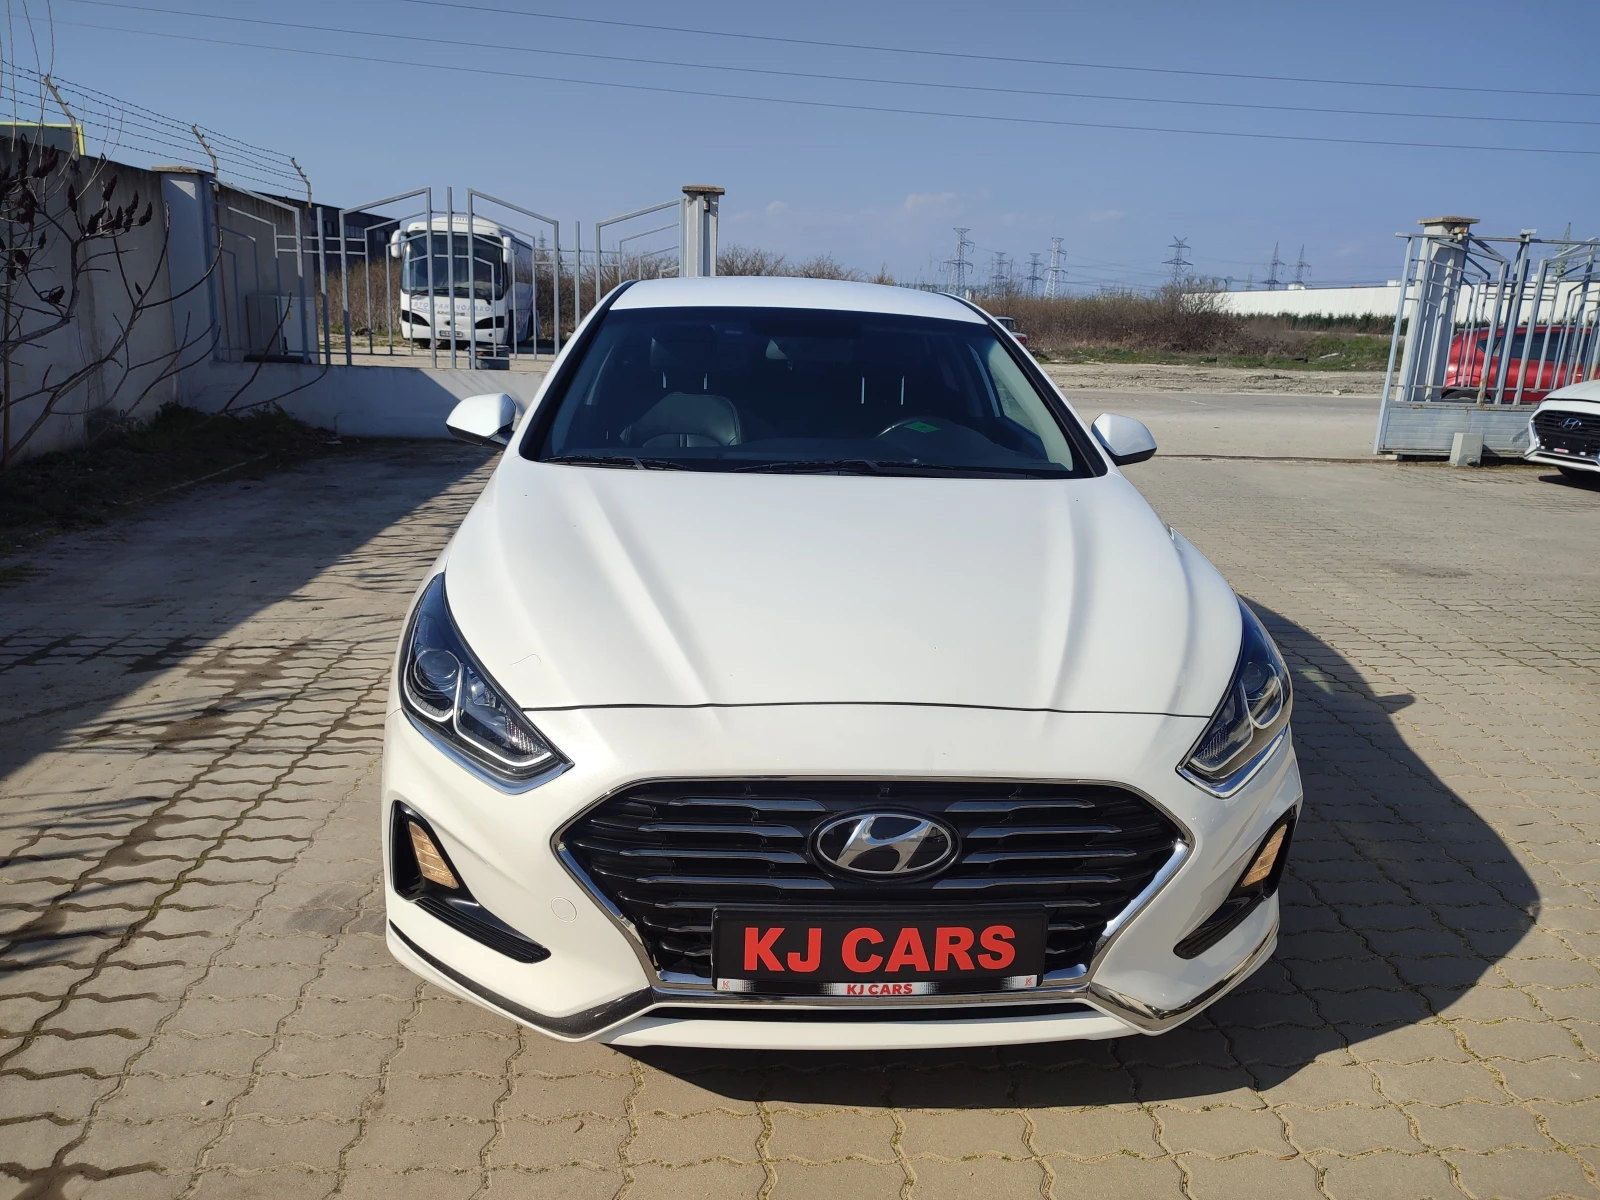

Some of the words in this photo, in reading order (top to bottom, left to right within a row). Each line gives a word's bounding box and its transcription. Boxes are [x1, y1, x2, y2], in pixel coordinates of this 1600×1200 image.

[743, 926, 823, 973] KJ
[841, 924, 1016, 974] CARS
[847, 984, 865, 995] KJ
[868, 983, 913, 996] CARS
